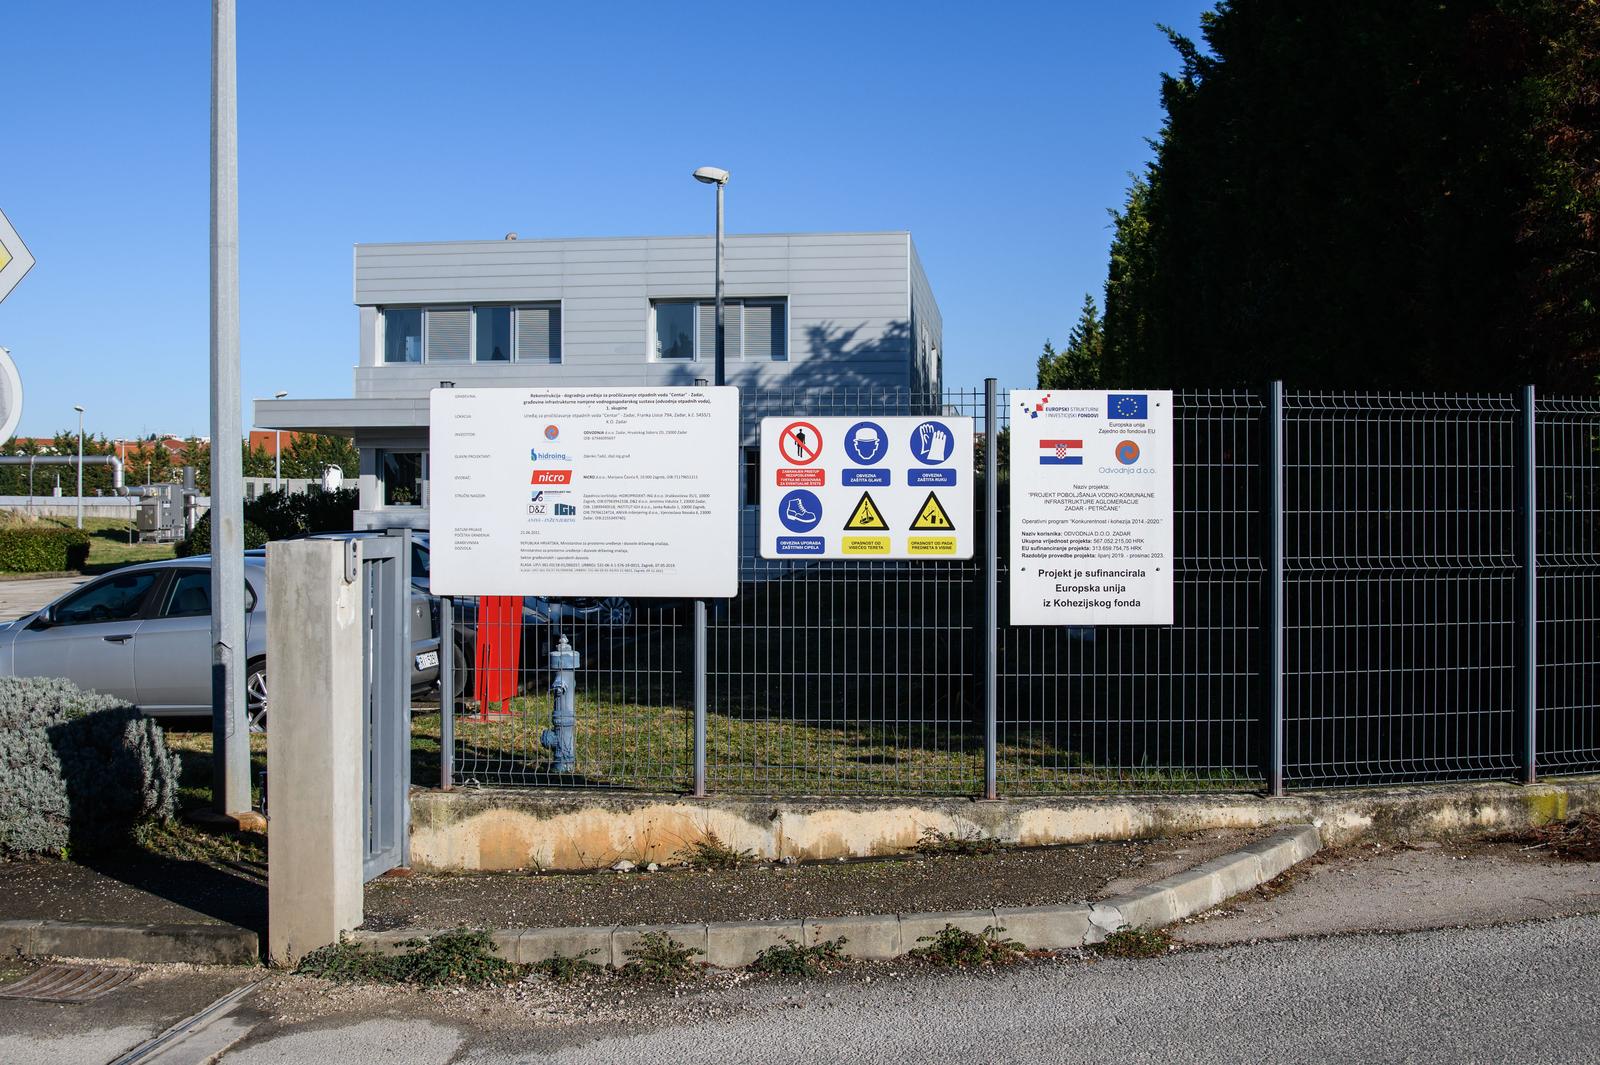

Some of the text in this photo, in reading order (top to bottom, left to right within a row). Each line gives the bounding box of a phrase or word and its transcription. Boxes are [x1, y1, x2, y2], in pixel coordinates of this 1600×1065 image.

[1098, 467, 1135, 475] Odvodnja
[538, 472, 565, 482] nicro
[528, 505, 546, 514] D&Z
[554, 503, 576, 516] IGH
[1038, 569, 1146, 580] Projekt je sufinancirala
[1055, 584, 1126, 594] Europska unija
[1043, 598, 1141, 609] iz Kohezijskog fonda
